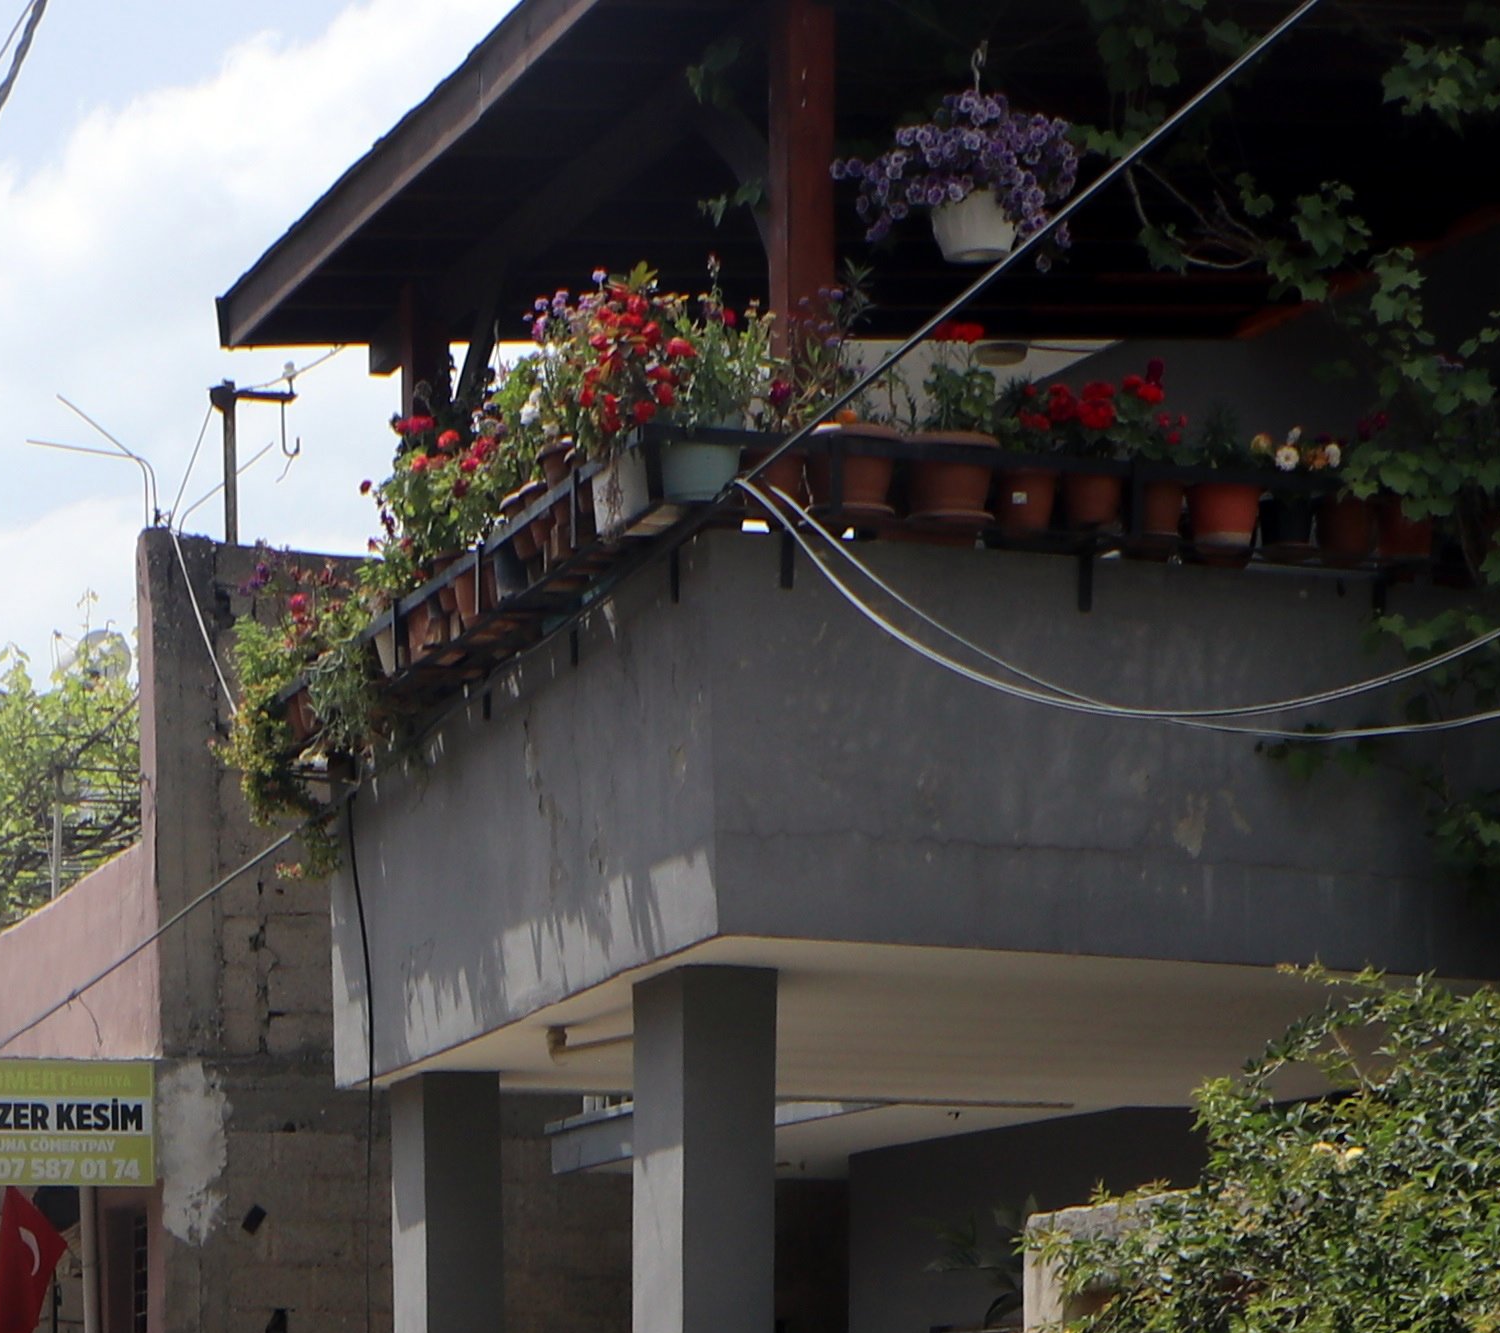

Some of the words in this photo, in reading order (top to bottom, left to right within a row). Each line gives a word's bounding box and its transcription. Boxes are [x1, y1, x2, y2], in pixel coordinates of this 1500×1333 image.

[56, 1098, 143, 1132] KESİM
[30, 1136, 116, 1153] CÖMERTPAY
[31, 1157, 75, 1180] 587
[80, 1157, 107, 1180] 01
[113, 1157, 141, 1180] 74
